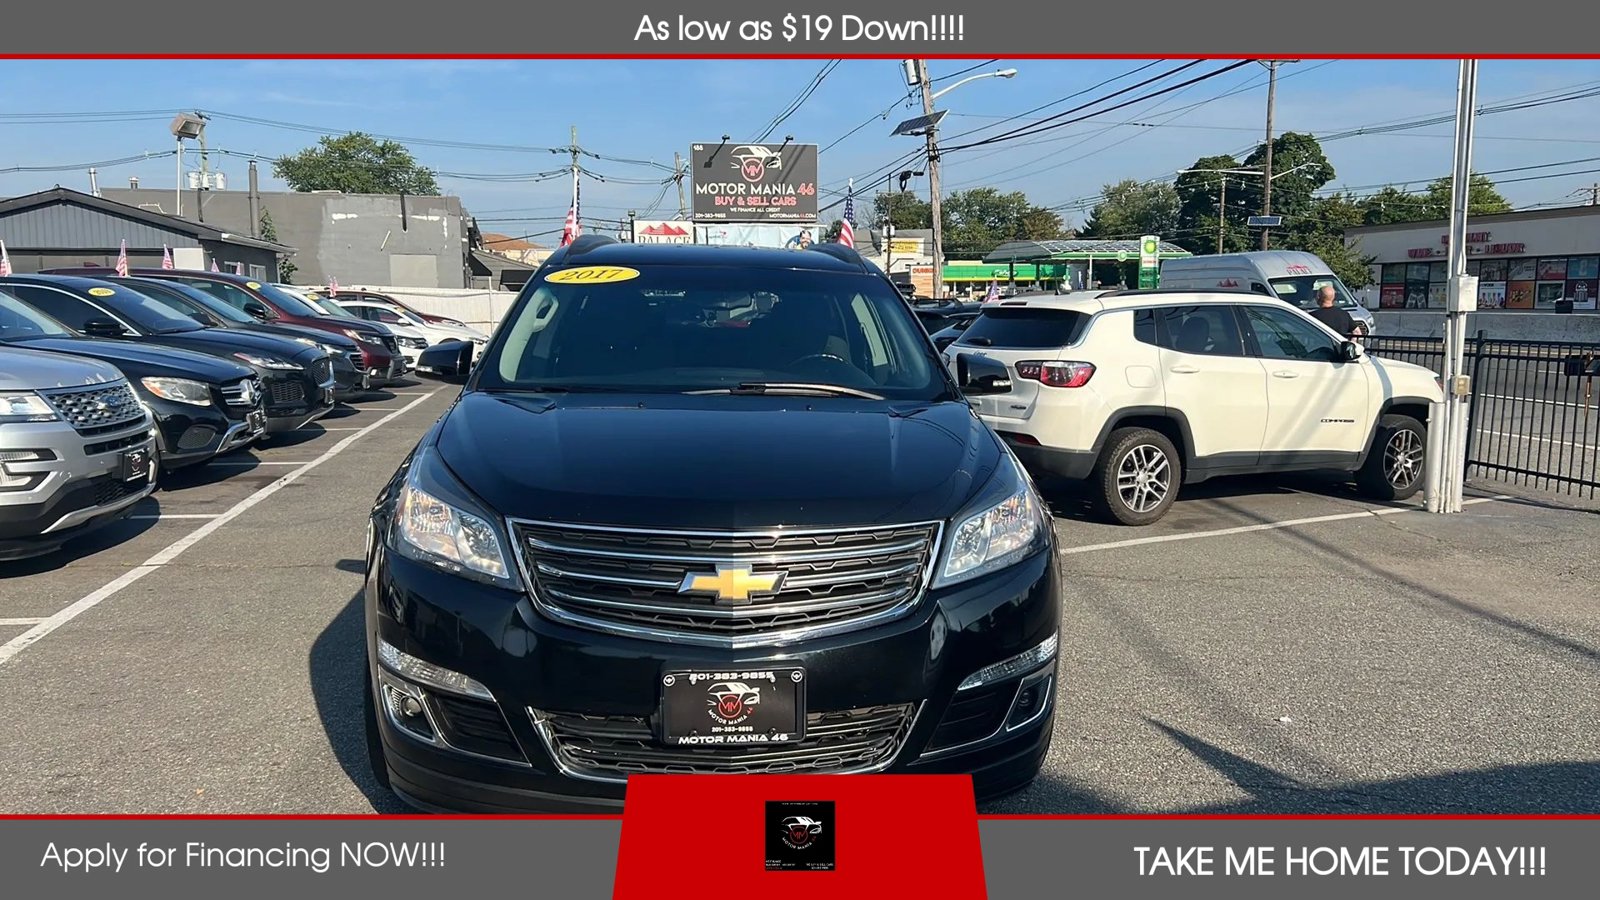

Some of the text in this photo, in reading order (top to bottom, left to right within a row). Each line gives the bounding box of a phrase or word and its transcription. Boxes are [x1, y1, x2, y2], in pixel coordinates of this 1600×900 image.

[695, 182, 815, 196] MOTOR MANIA 46
[715, 197, 797, 206] BUY & SELL CARS
[559, 269, 624, 281] 2017
[708, 709, 727, 725] MOTOR
[728, 714, 748, 725] MANIA
[678, 733, 789, 745] MOTOR MANIA 46
